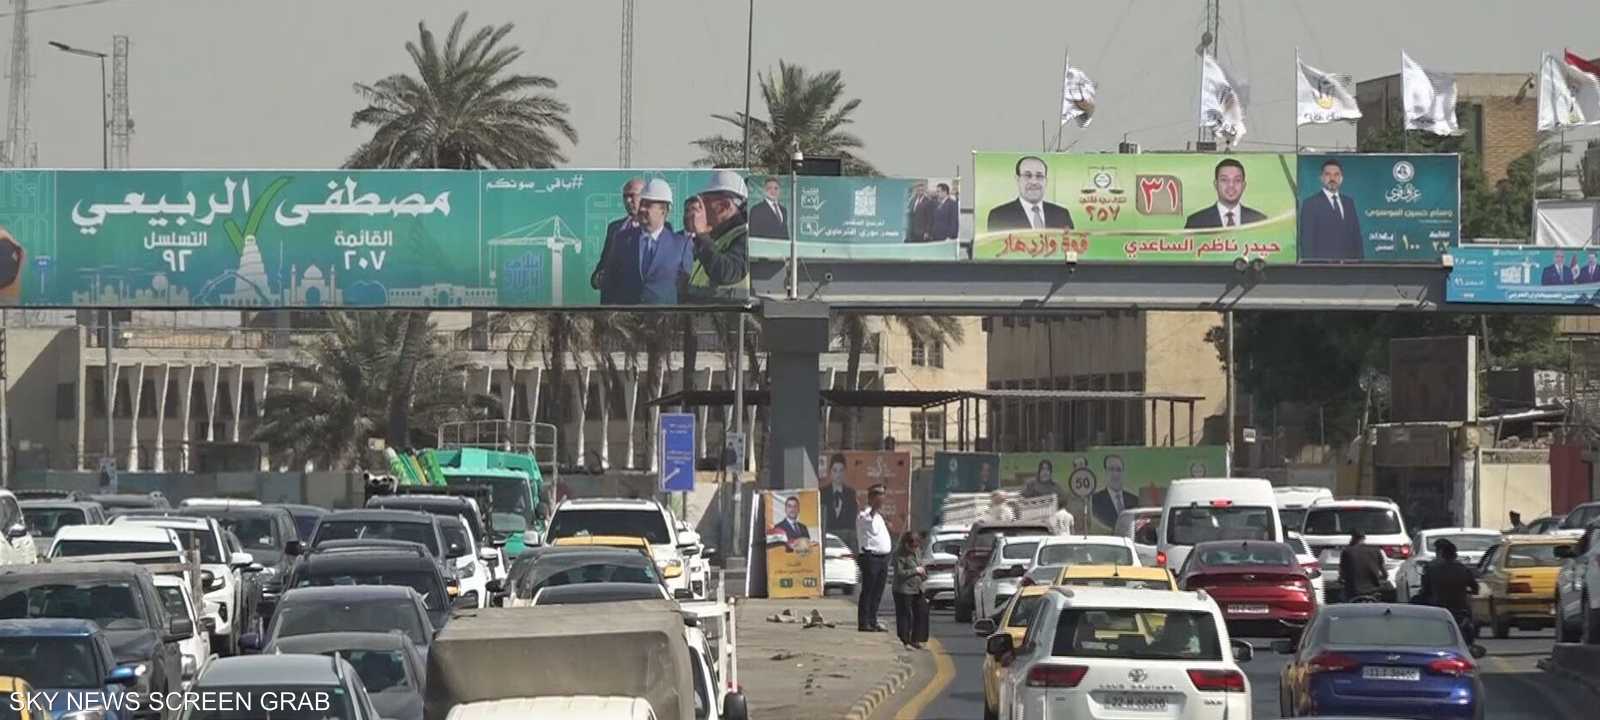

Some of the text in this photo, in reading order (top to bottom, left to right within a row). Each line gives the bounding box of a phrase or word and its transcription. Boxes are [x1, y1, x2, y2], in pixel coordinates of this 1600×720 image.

[486, 174, 584, 192] #باقي_صوتكم
[1140, 177, 1178, 213] ٣١
[71, 176, 451, 235] مصطفى الربيعي
[1085, 204, 1121, 222] ٢٥٧
[143, 231, 208, 249] التسلسل
[334, 230, 393, 247] القائمة
[1124, 237, 1281, 258] حيدر ناظم الساعدي
[344, 250, 386, 270] ٢٠٧
[1075, 478, 1090, 489] 50
